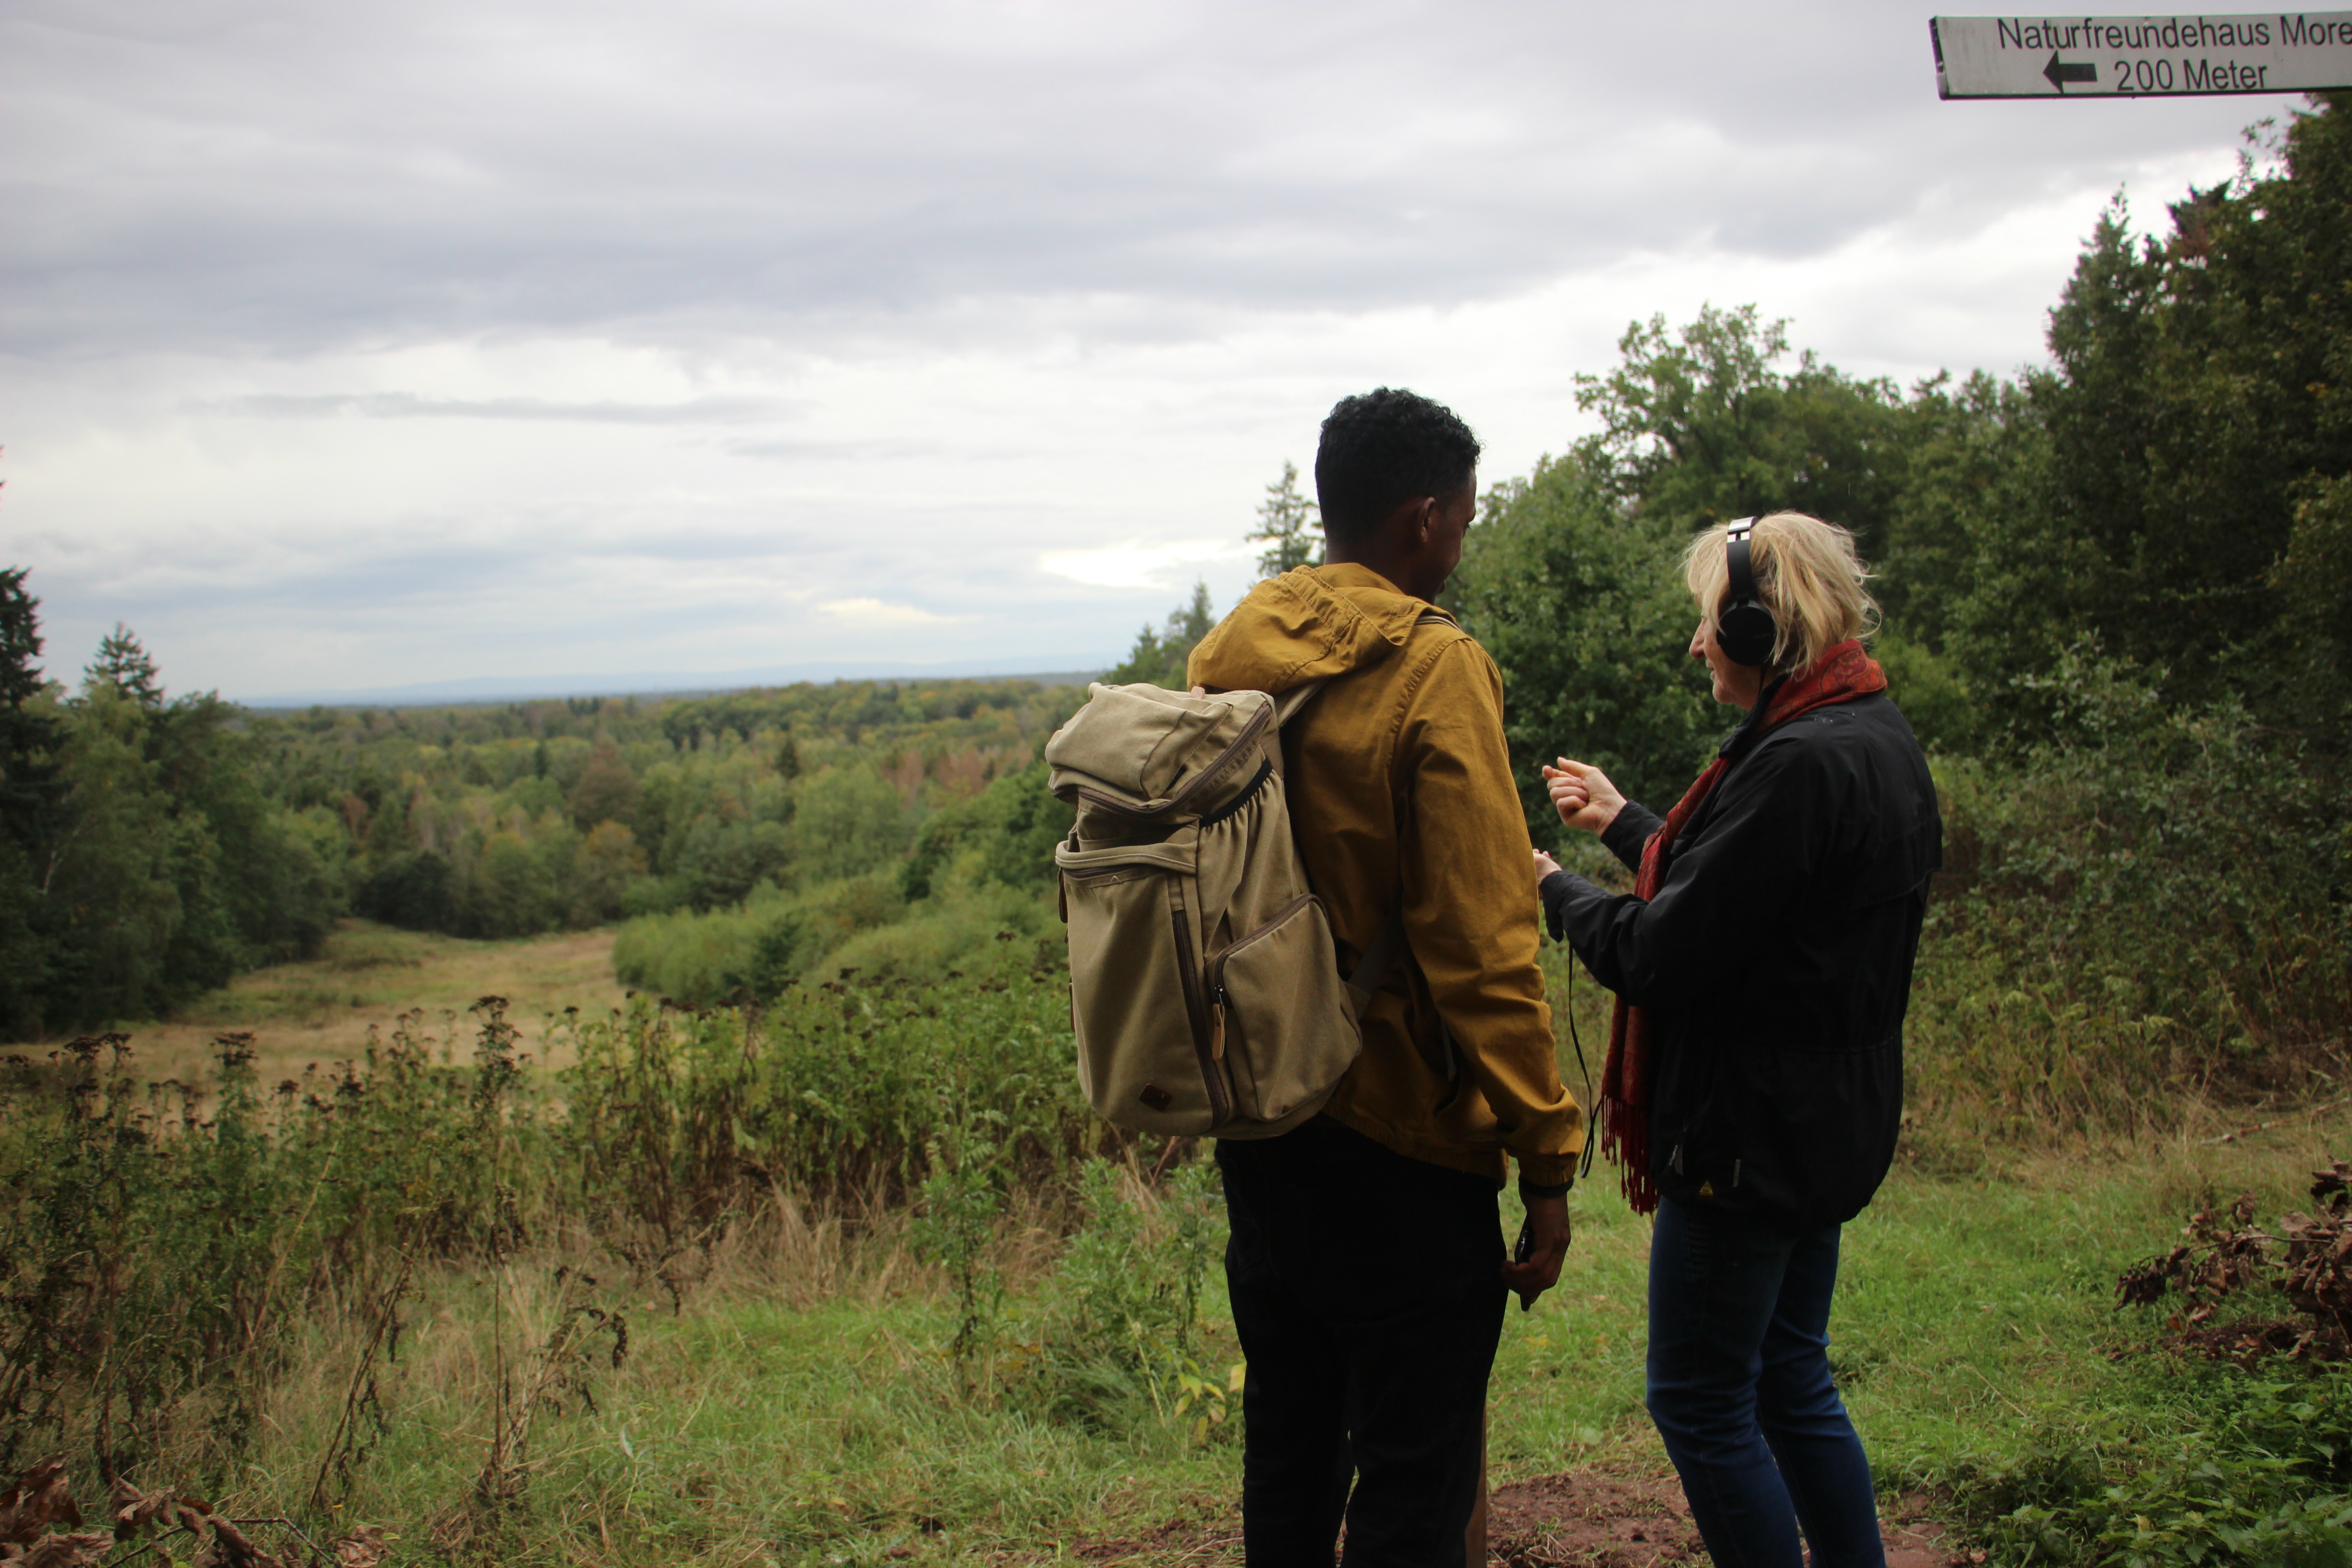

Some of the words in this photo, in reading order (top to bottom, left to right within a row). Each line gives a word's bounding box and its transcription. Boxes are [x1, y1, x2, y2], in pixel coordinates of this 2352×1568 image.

[1997, 16, 2270, 49] Naturfreundehaus
[2114, 59, 2173, 92] 200
[2183, 57, 2268, 89] Meter
